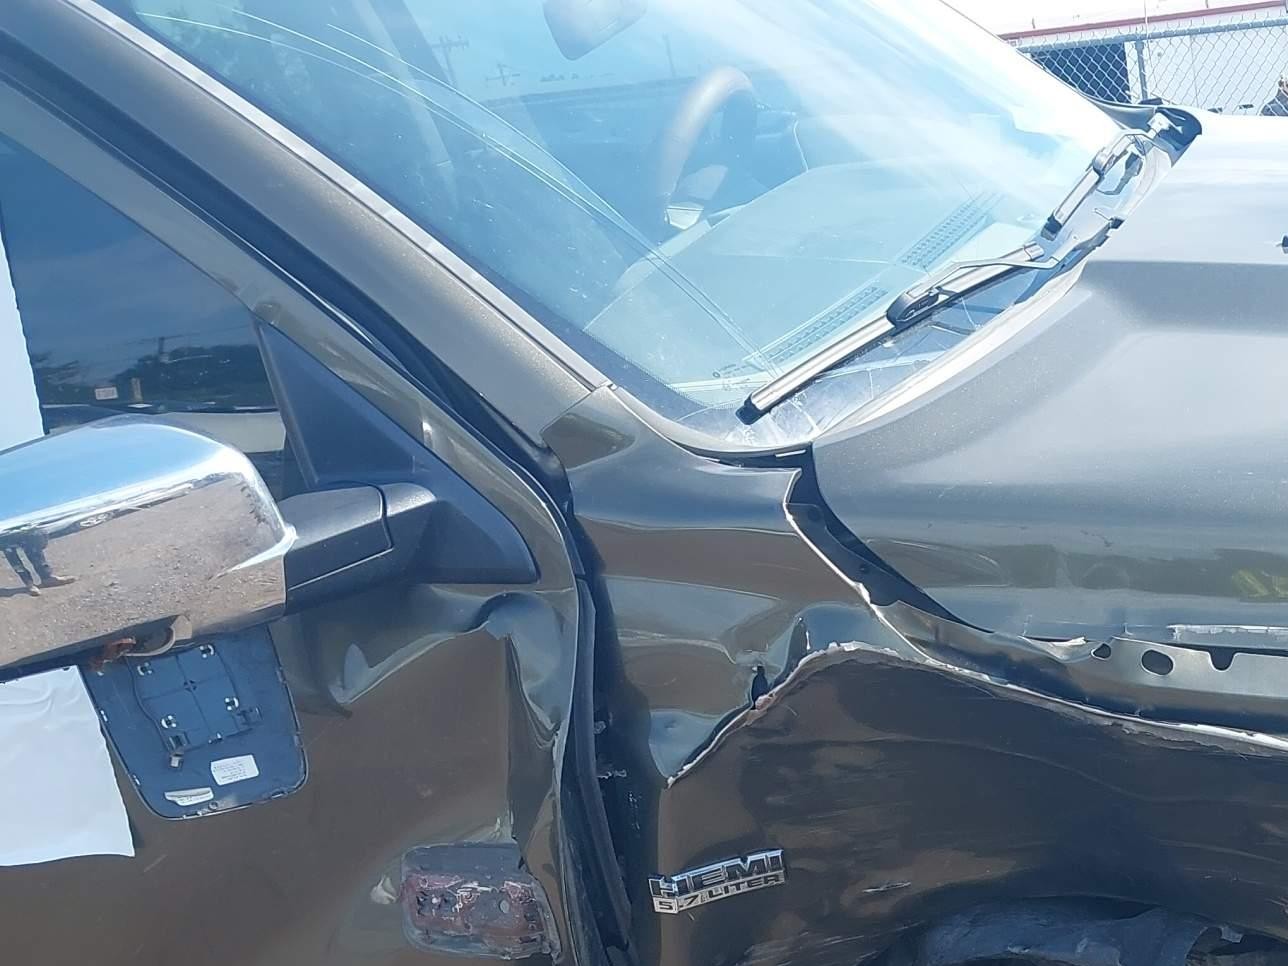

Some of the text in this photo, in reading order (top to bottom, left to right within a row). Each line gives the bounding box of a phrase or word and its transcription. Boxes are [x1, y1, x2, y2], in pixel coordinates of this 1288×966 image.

[648, 850, 784, 898] HEMI
[659, 874, 781, 911] 5.7 LITER
